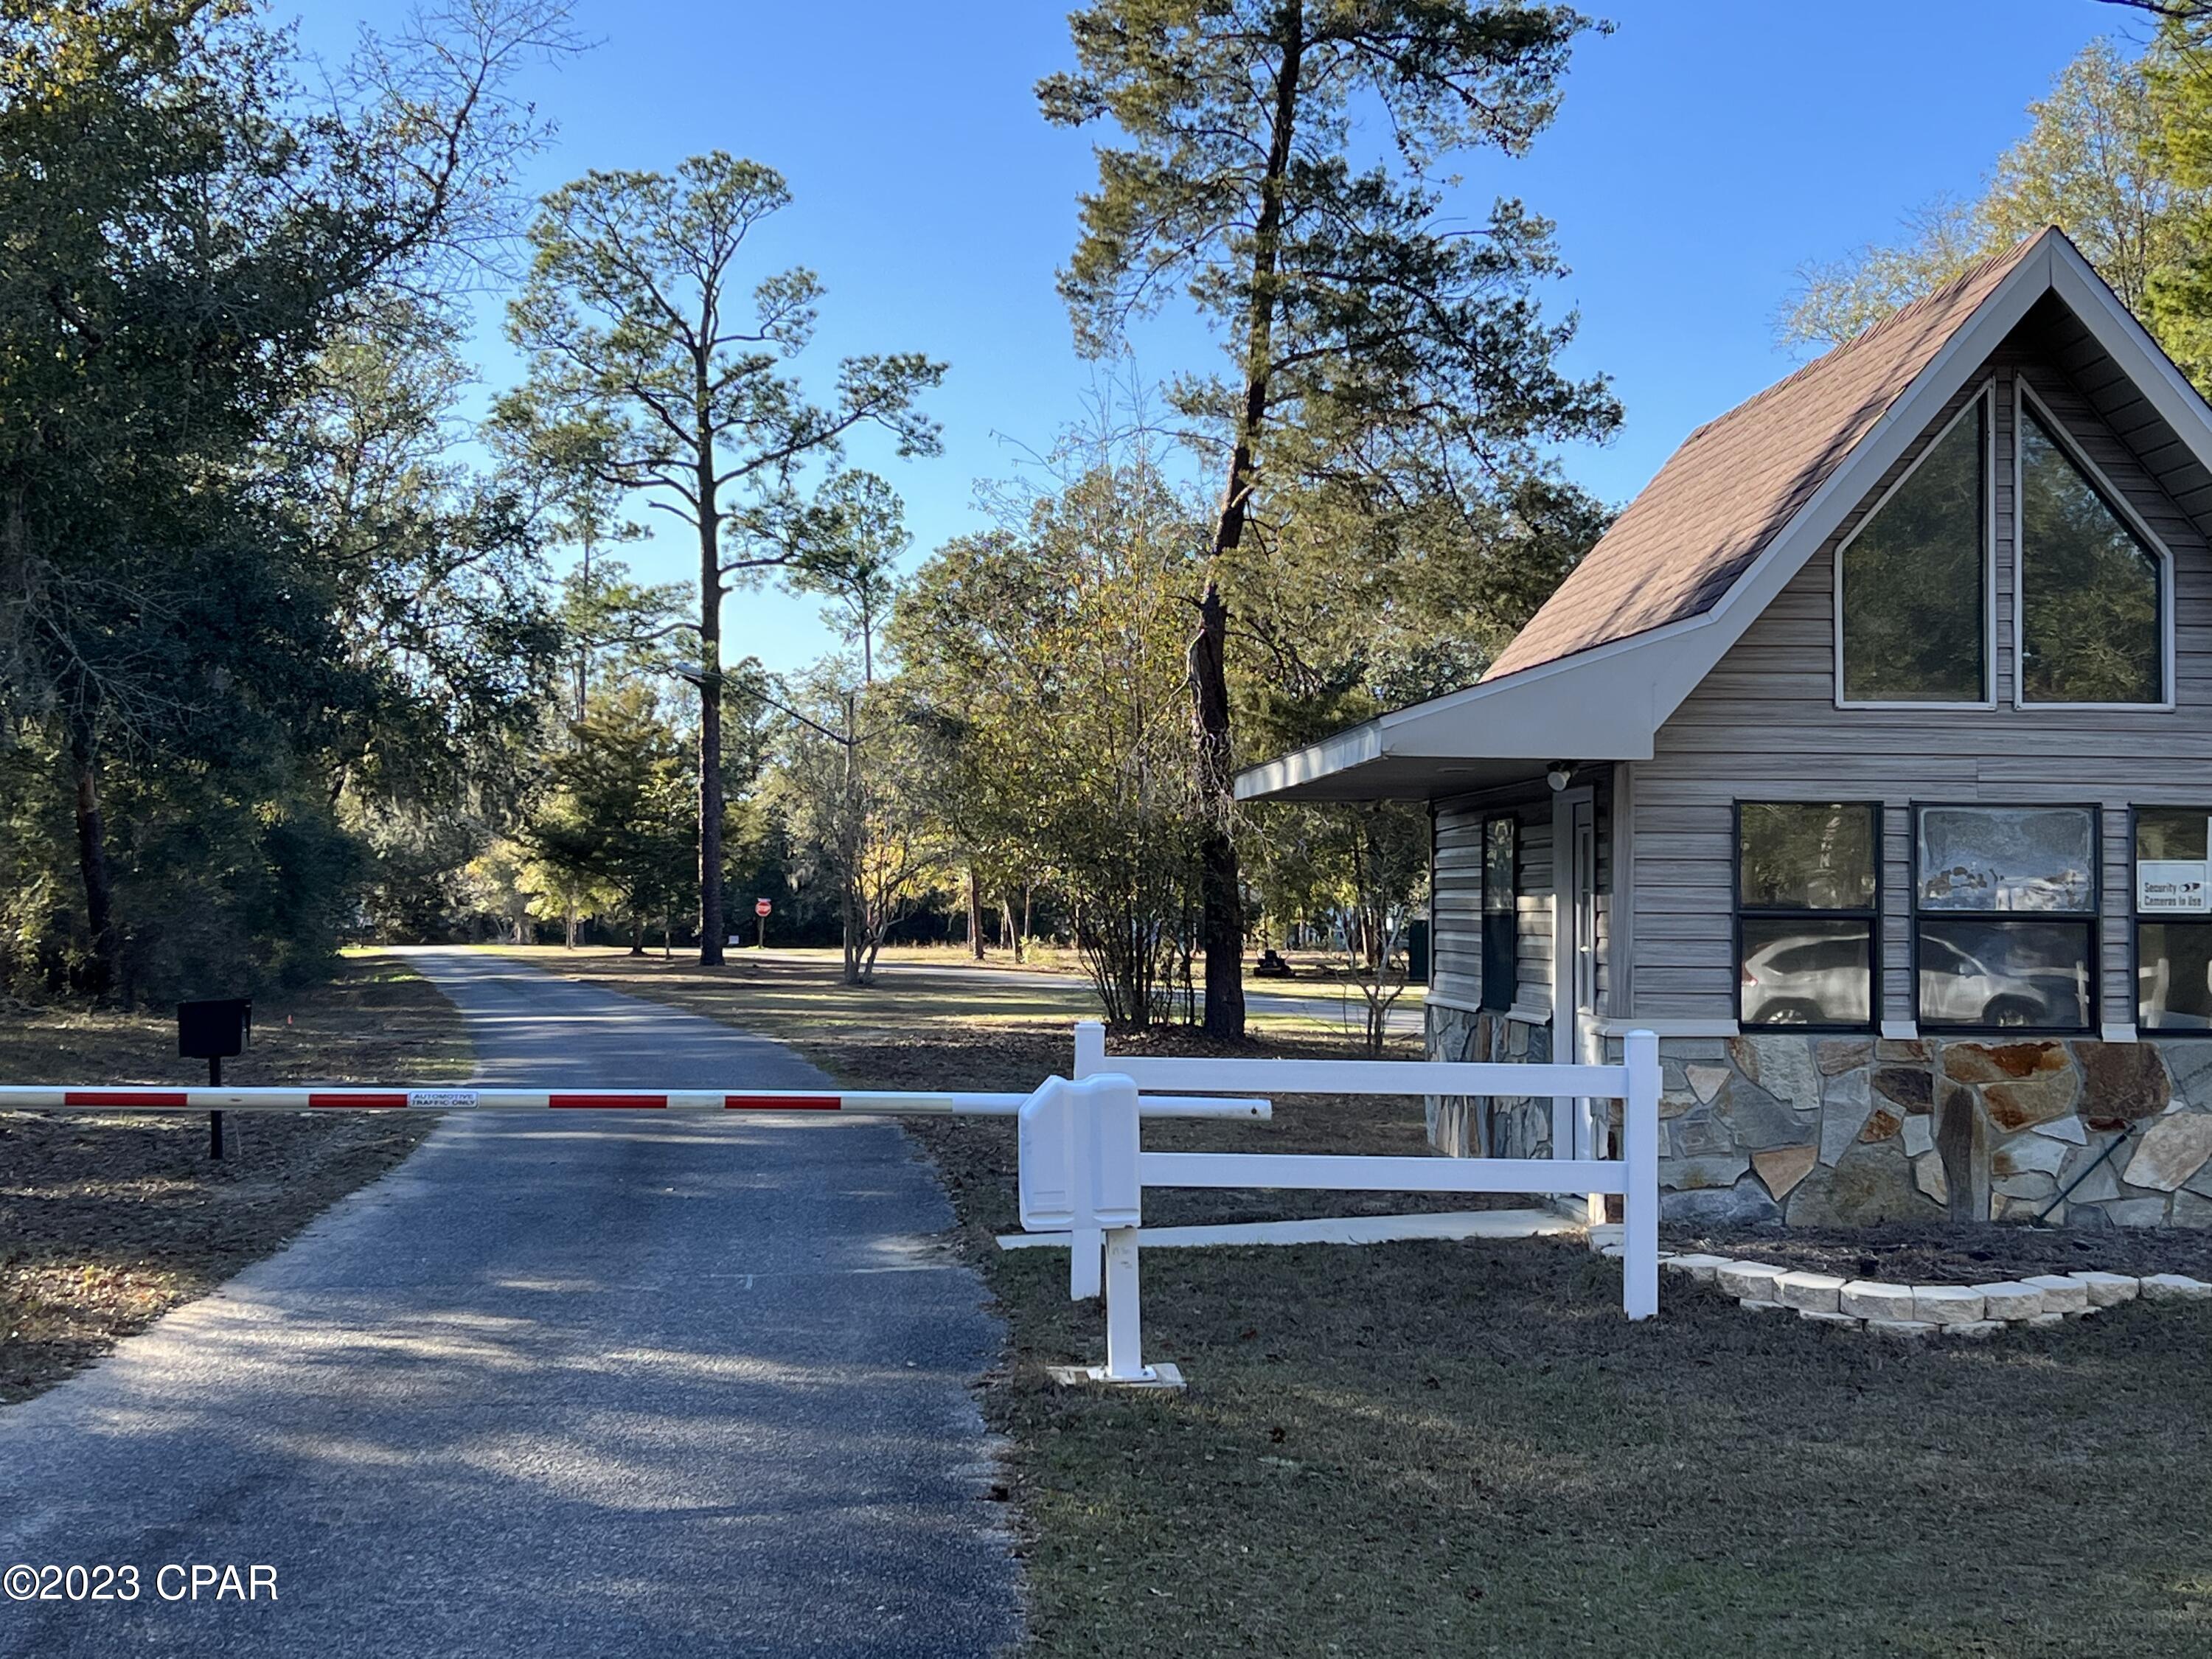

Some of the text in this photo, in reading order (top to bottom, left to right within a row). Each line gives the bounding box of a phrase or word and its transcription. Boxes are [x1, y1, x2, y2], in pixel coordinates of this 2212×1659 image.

[2144, 883, 2177, 895] Security
[2144, 896, 2177, 906] Cameras
[2188, 896, 2202, 906] Use
